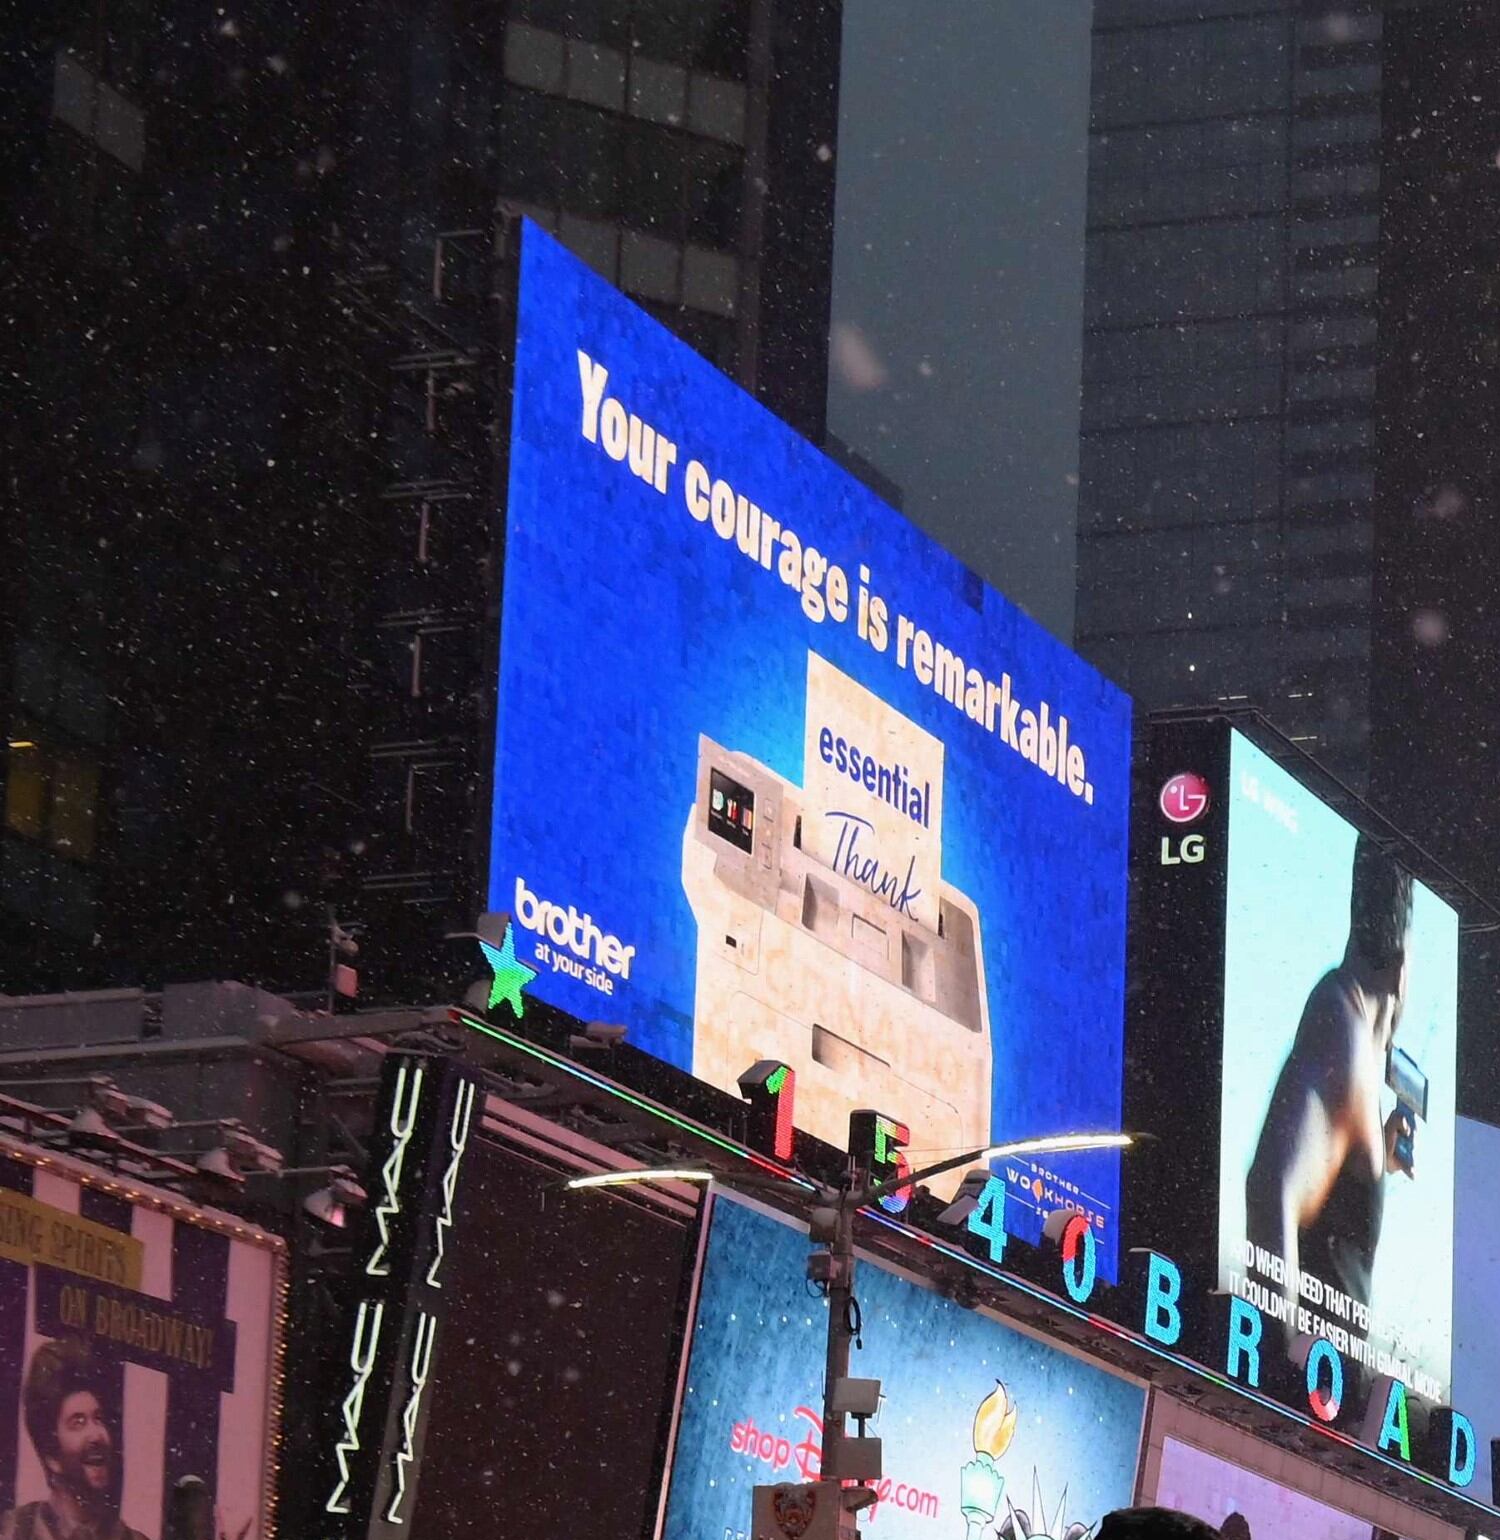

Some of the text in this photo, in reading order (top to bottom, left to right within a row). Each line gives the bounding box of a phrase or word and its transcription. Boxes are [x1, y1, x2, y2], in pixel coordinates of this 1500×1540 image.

[577, 349, 676, 496] Your
[685, 459, 848, 624] courage
[858, 566, 888, 653] is
[898, 612, 1094, 803] remarkable.
[819, 725, 931, 829] essential
[825, 811, 919, 922] Thank
[1161, 837, 1205, 866] LG
[515, 876, 635, 980] brother
[535, 943, 613, 995] at your side
[1006, 1166, 1105, 1229] WOKHORSE
[1030, 1162, 1080, 1196] BROTHER
[1256, 1246, 1351, 1319] WHEN NEED THAT
[1242, 1279, 1298, 1328] COULDN'T
[1298, 1306, 1312, 1334] BE
[1350, 1333, 1377, 1369] WITH
[1413, 1368, 1442, 1404] MODE
